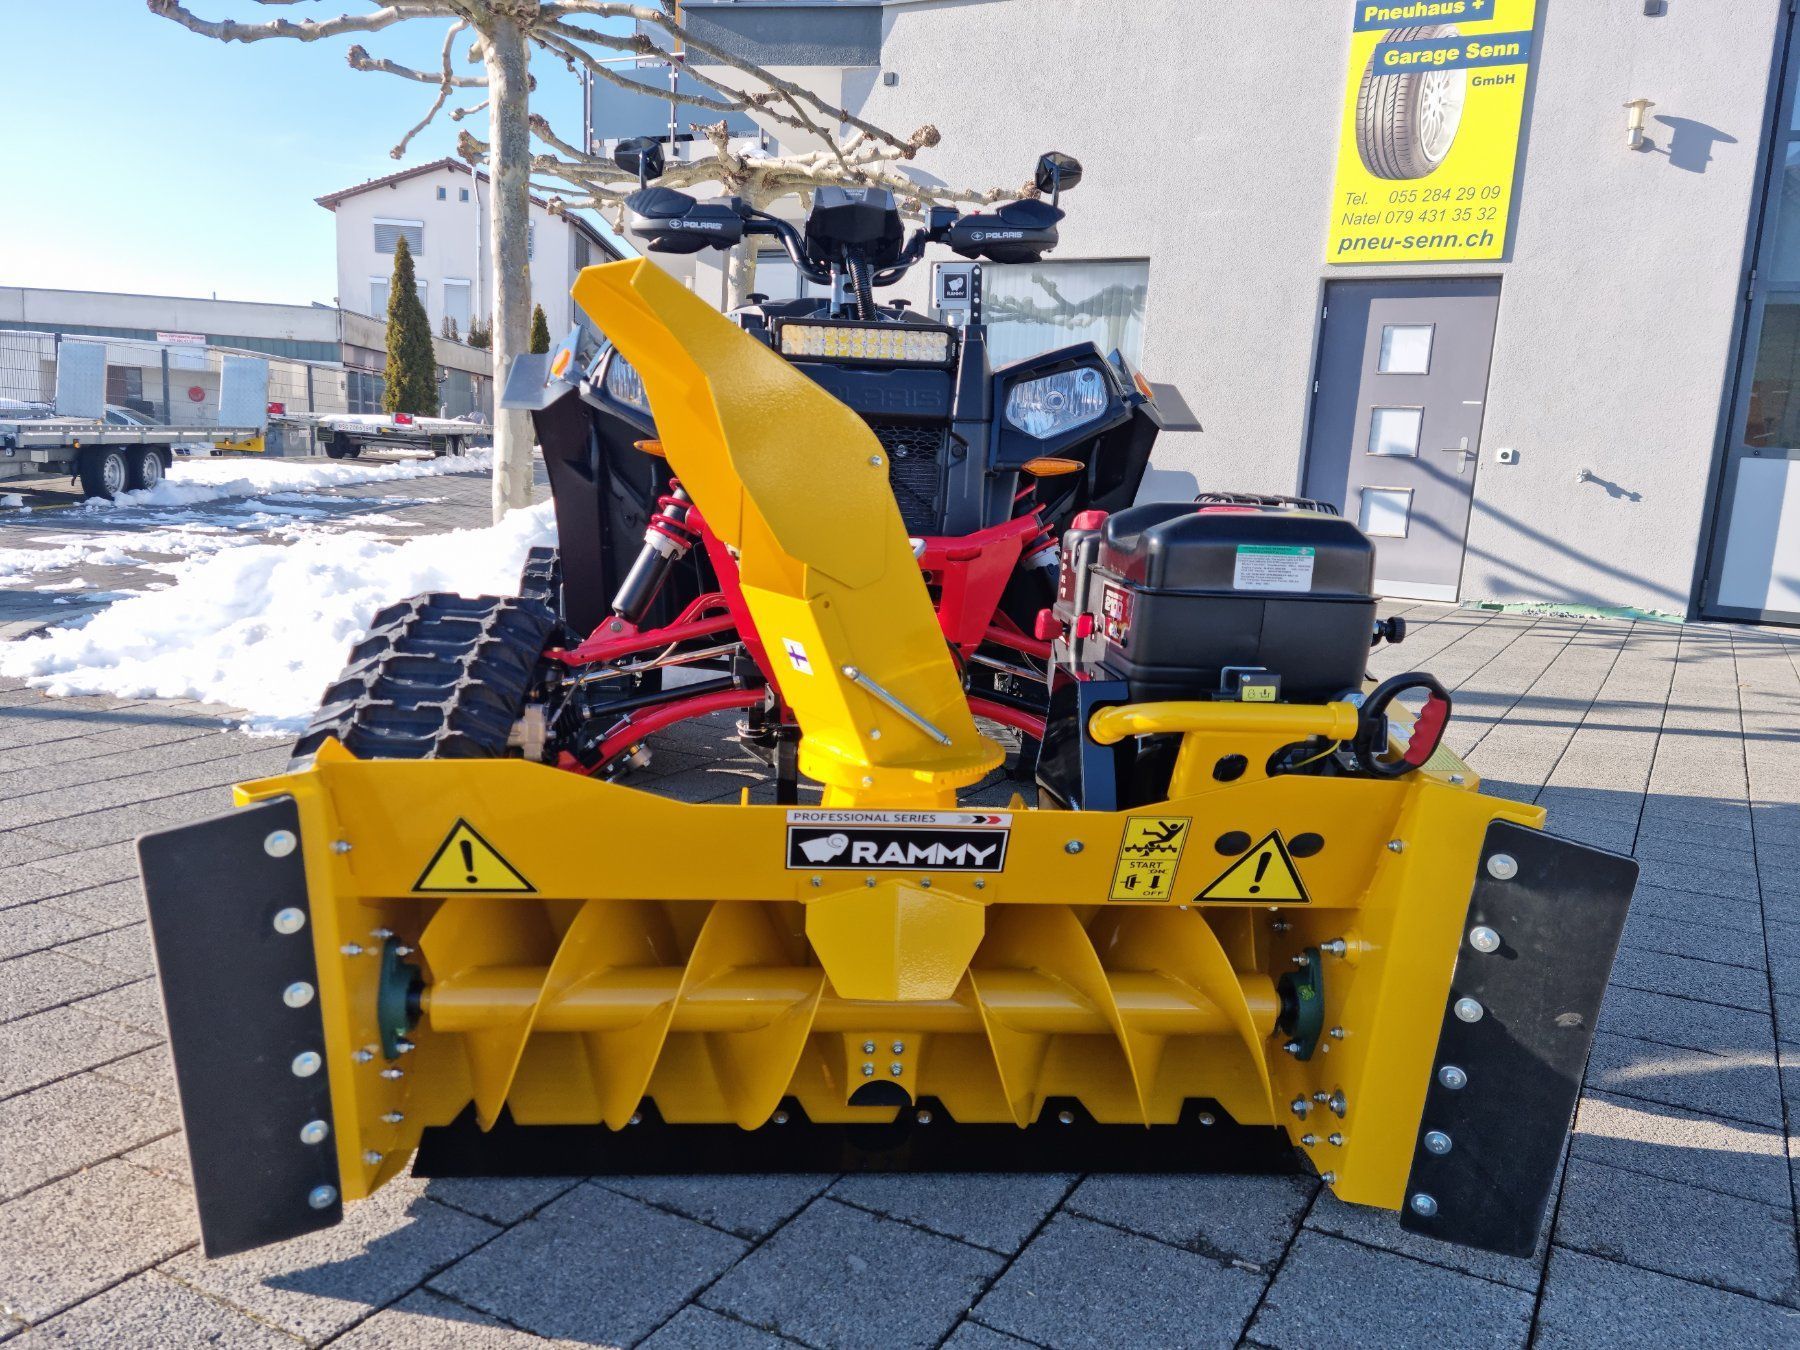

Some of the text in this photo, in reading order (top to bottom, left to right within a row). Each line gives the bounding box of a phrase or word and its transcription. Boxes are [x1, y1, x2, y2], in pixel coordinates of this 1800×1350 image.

[1364, 1, 1466, 22] Pneuhaus
[1384, 42, 1520, 66] Garage Senn
[1472, 73, 1516, 87] GmbH
[1346, 185, 1501, 206] Tel. 055 284 29 09
[683, 221, 723, 230] POLARIS
[1341, 206, 1497, 226] Natel 079 431 35 32
[985, 231, 1024, 239] POLARIS
[1337, 228, 1494, 255] pneu-senn.ch
[793, 812, 936, 823] PROFESSIONAL SERIES
[851, 841, 997, 866] RAMMY
[1130, 861, 1164, 869] START
